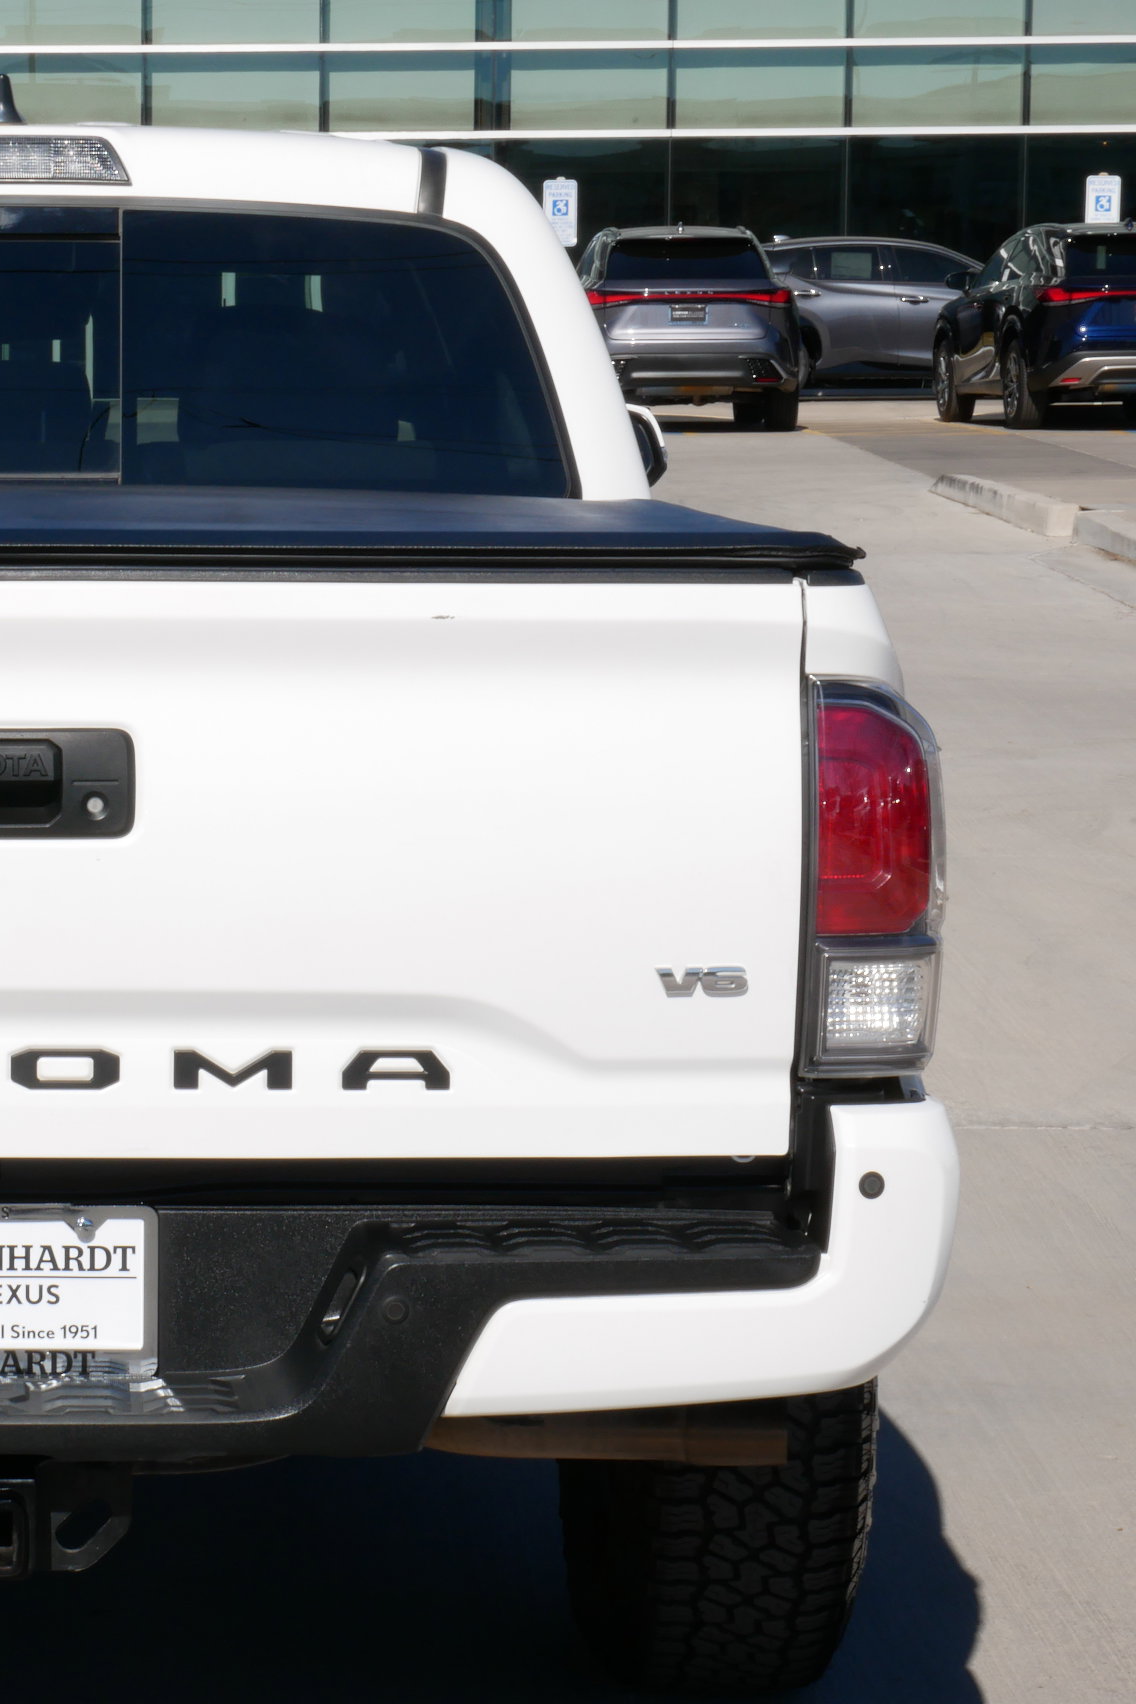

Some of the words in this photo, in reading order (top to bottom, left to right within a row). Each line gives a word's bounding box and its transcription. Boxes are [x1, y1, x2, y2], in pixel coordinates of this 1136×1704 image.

[655, 965, 749, 998] V6
[10, 1324, 55, 1340] Since
[60, 1324, 99, 1340] 1951
